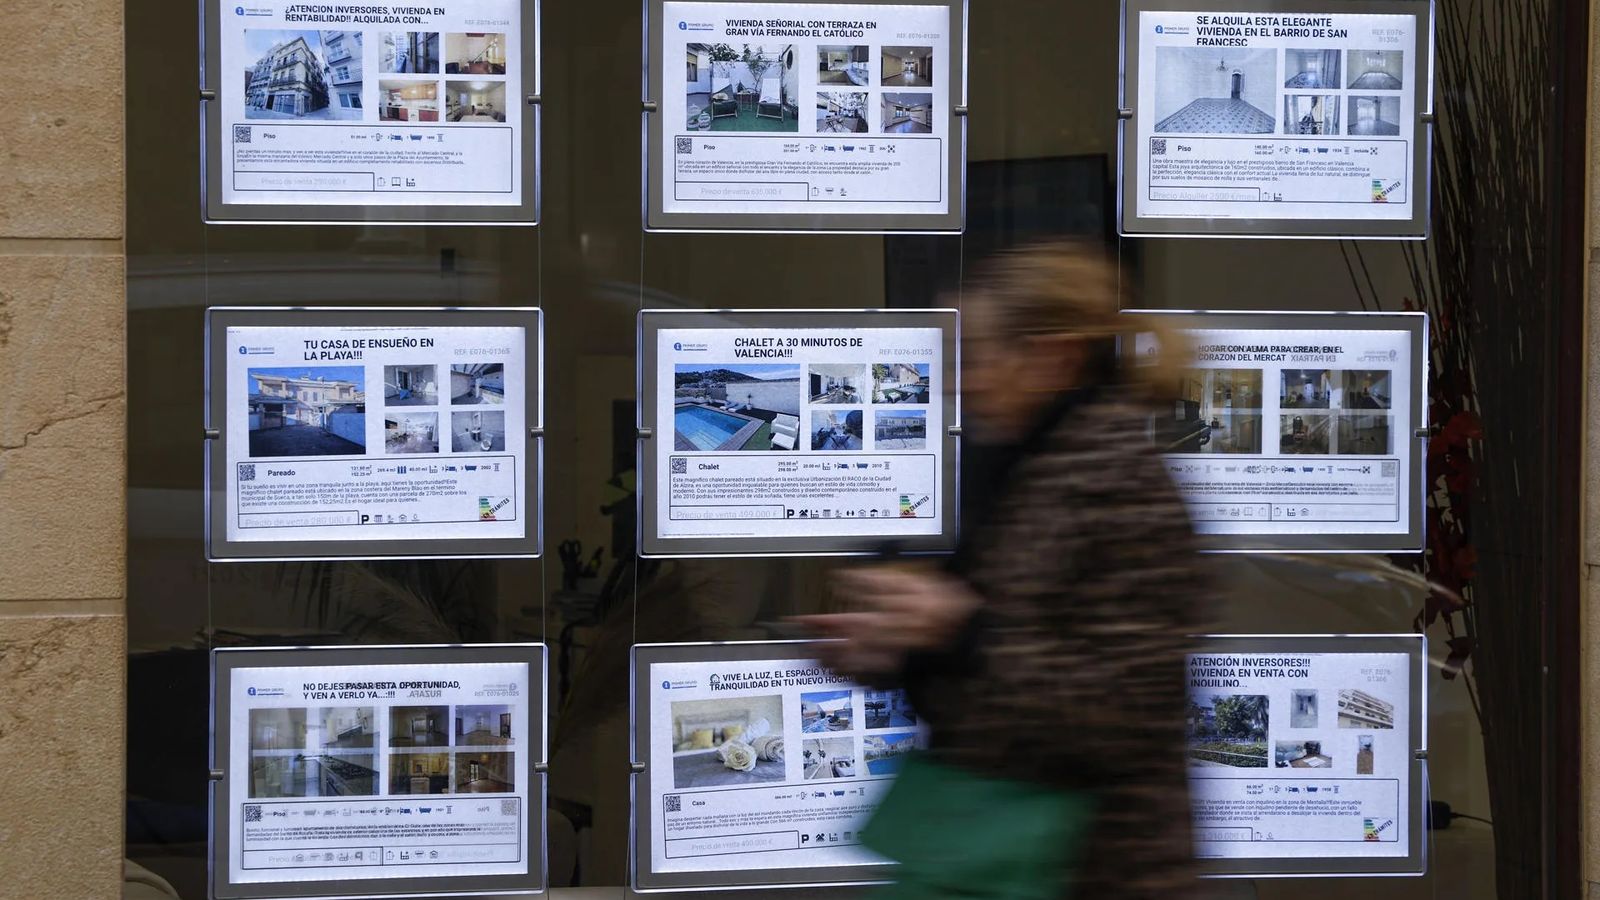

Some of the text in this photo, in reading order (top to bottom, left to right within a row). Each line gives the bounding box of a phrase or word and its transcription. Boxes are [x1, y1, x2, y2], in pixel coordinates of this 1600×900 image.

[285, 6, 333, 14] ¿ATENCION
[334, 7, 389, 15] INVERSORES,
[285, 14, 428, 24] RENTABILIDAD!! ALQUILADA CON...
[726, 20, 763, 28] VIVIENDA
[765, 19, 805, 28] SEÑORIAL
[807, 21, 825, 29] CON
[827, 21, 863, 29] TERRAZA
[1197, 16, 1331, 26] SE ALQUILA ESTA ELEGANTE
[750, 27, 764, 36] VÍA
[766, 29, 810, 37] FERNANDO
[823, 28, 864, 38] CATÓLICO
[1197, 27, 1241, 36] VIVIENDA
[1244, 28, 1257, 37] EN
[1260, 28, 1270, 37] EL
[1273, 28, 1309, 37] BARRIO
[1312, 29, 1324, 37] DE
[1327, 29, 1347, 38] SAN
[1197, 38, 1248, 46] FRANCESC
[304, 337, 434, 349] TU CASA DE ENSUEÑO EN
[734, 338, 863, 347] CHALET A 30 MINUTOS DE
[304, 351, 362, 361] LA PLAYA!!!
[734, 349, 793, 358] VALENCIA!!!
[1191, 658, 1239, 666] ATENCIÓN
[755, 672, 771, 680] LUZ,
[785, 669, 820, 677] ESPACIO
[375, 682, 396, 690] ESTA
[398, 682, 460, 690] OPORTUNIDAD,
[710, 681, 768, 692] TRANQUILIDAD
[795, 678, 823, 686] NUEVO
[303, 692, 308, 700] Y
[311, 692, 327, 700] VEN
